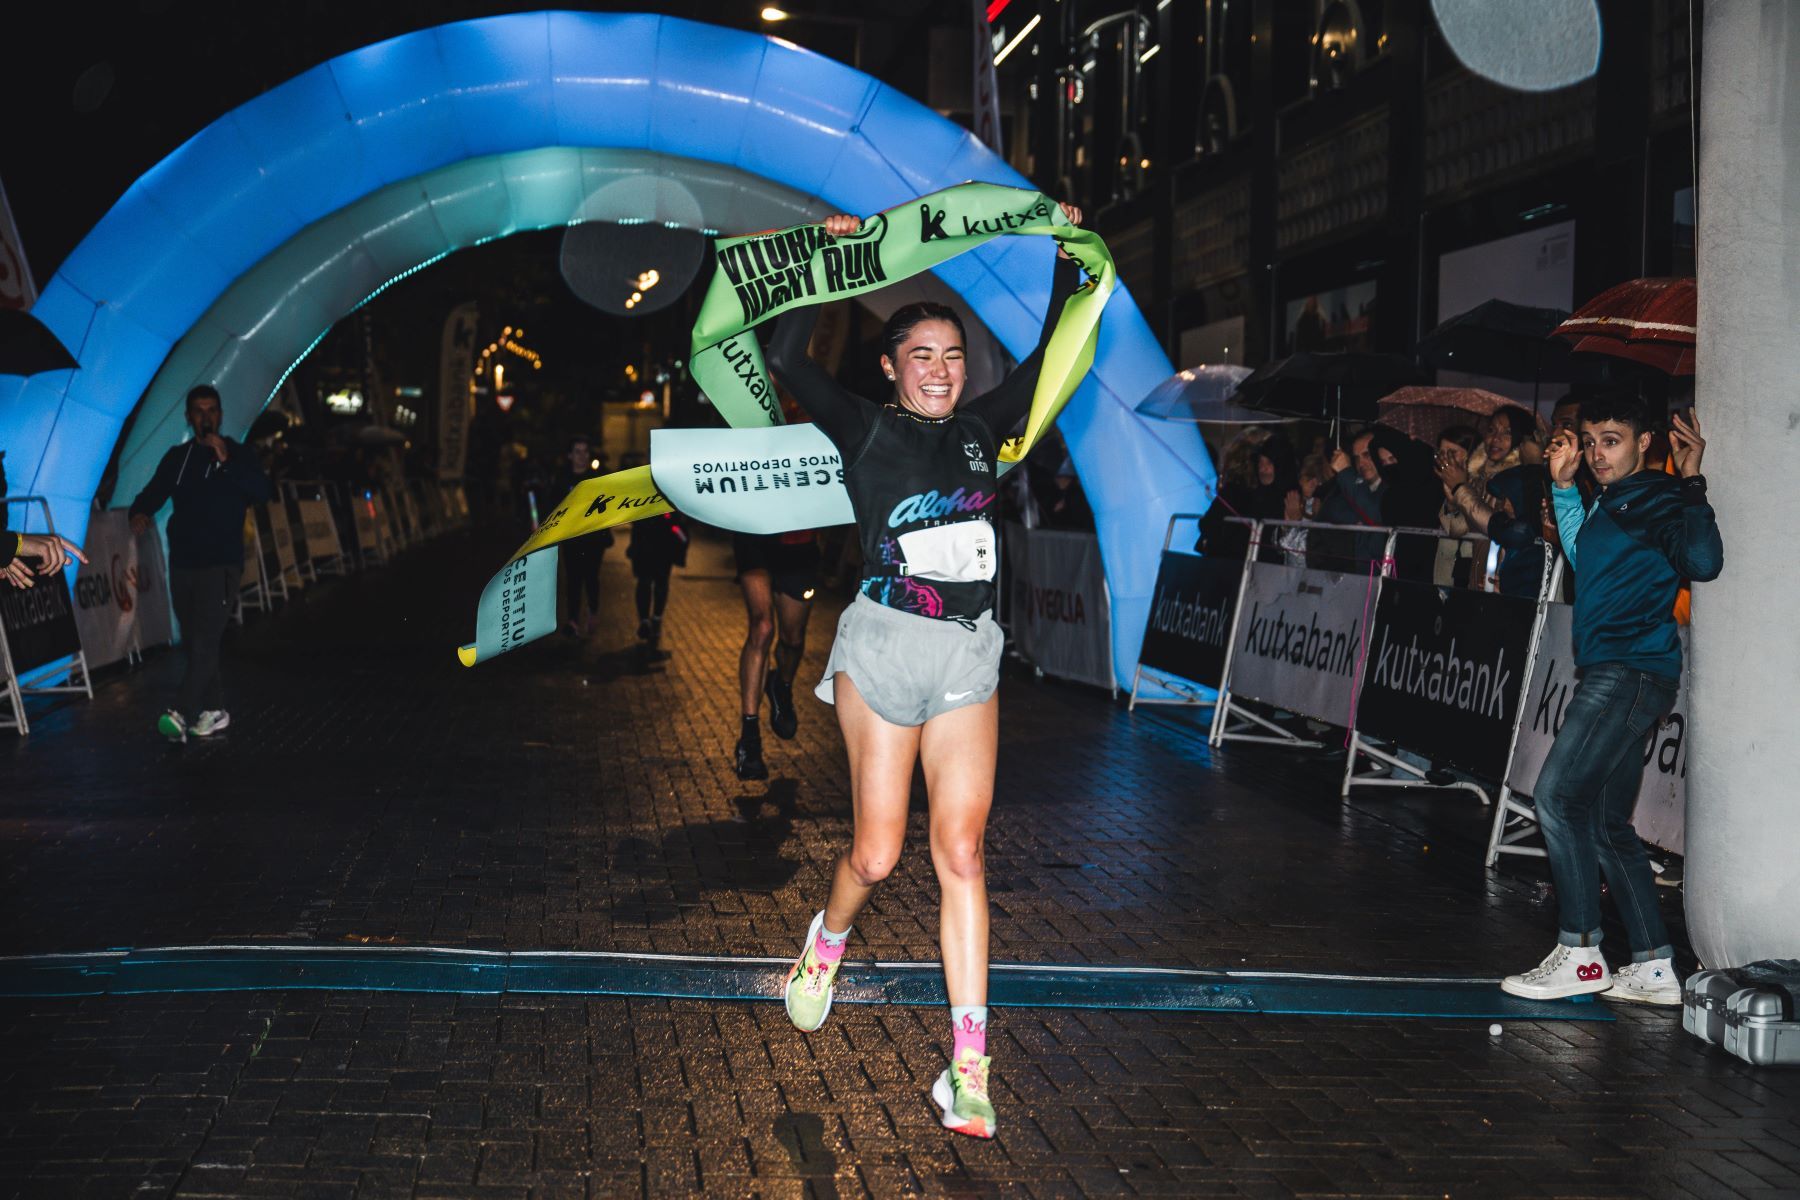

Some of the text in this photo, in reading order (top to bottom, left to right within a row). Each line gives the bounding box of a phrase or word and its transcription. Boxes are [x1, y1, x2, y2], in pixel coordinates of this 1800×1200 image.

[693, 459, 791, 474] DEPORTIVOS
[969, 460, 989, 473] OTSO
[1152, 585, 1229, 647] kutxabank
[1245, 602, 1360, 678] kutxabank
[1373, 624, 1511, 720] kutxabank
